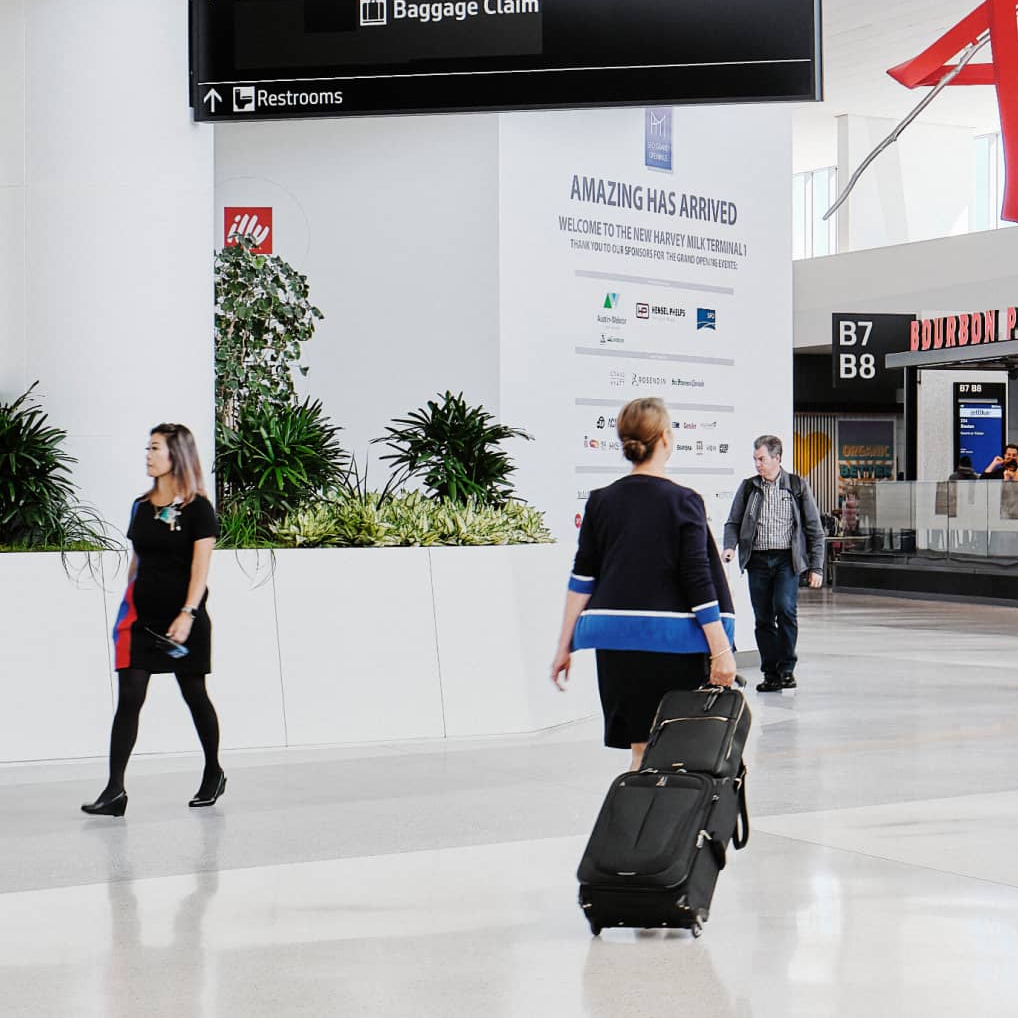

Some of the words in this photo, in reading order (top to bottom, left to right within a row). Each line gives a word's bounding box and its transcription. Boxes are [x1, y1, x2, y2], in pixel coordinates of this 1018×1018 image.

[393, 0, 478, 22] Baggage
[257, 90, 343, 107] Restrooms
[570, 174, 643, 211] AMAZING
[647, 187, 676, 216] HAS
[680, 193, 737, 225] ARRIVED
[227, 214, 270, 247] illy
[558, 215, 602, 236] WELCOME
[603, 222, 615, 238] TO
[616, 224, 632, 240] THE
[634, 227, 652, 243] NEW
[653, 229, 686, 247] HARVEY
[686, 234, 706, 251] MILK
[706, 238, 743, 256] TERMINAL
[570, 238, 590, 250] THANK
[591, 241, 603, 252] YOU
[603, 243, 611, 253] TO
[612, 244, 624, 254] OUR
[625, 246, 653, 259] SPONSORS
[653, 250, 664, 260] FOR
[839, 320, 873, 346] B7
[910, 309, 1000, 351] BOURBON
[839, 353, 876, 379] B8
[959, 384, 970, 393] B7
[971, 384, 982, 393] B8
